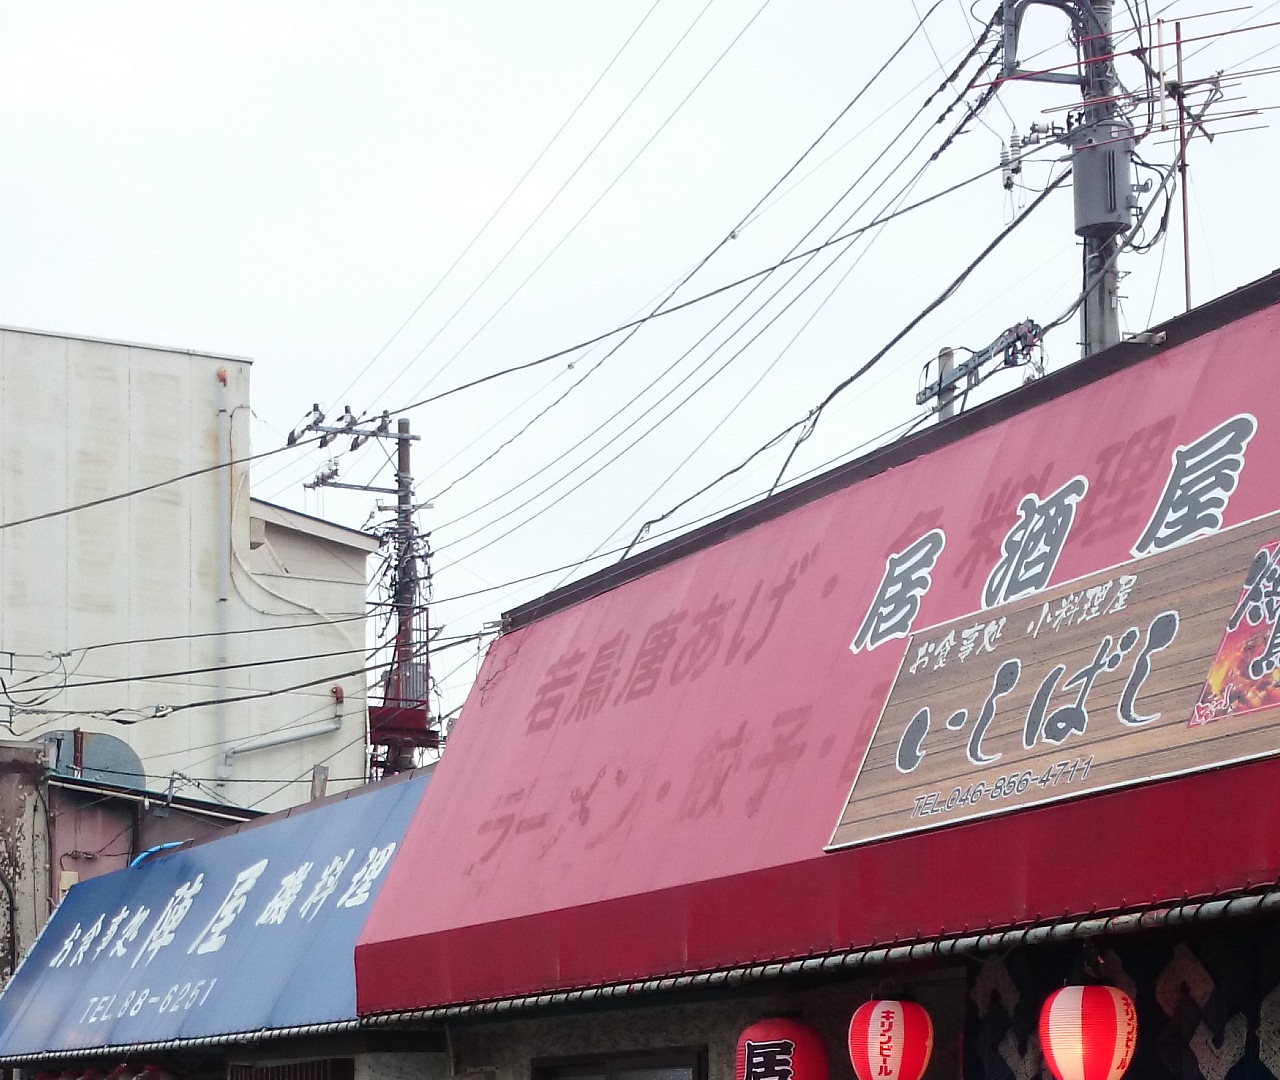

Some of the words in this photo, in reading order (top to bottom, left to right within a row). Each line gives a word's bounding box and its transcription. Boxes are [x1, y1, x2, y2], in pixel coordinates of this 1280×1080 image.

[850, 413, 1258, 656] 居酒屋
[909, 616, 1007, 674] お食事処
[1027, 575, 1137, 639] 小料理屋
[896, 610, 1179, 773] いしばし
[911, 755, 1095, 818] TEL.046-856-4711
[50, 905, 151, 968] お食事処
[131, 859, 269, 969] 陣屋
[255, 842, 397, 927] 磯料理
[80, 978, 218, 1024] TEL.88-6251
[878, 1009, 895, 1076] キリンビール
